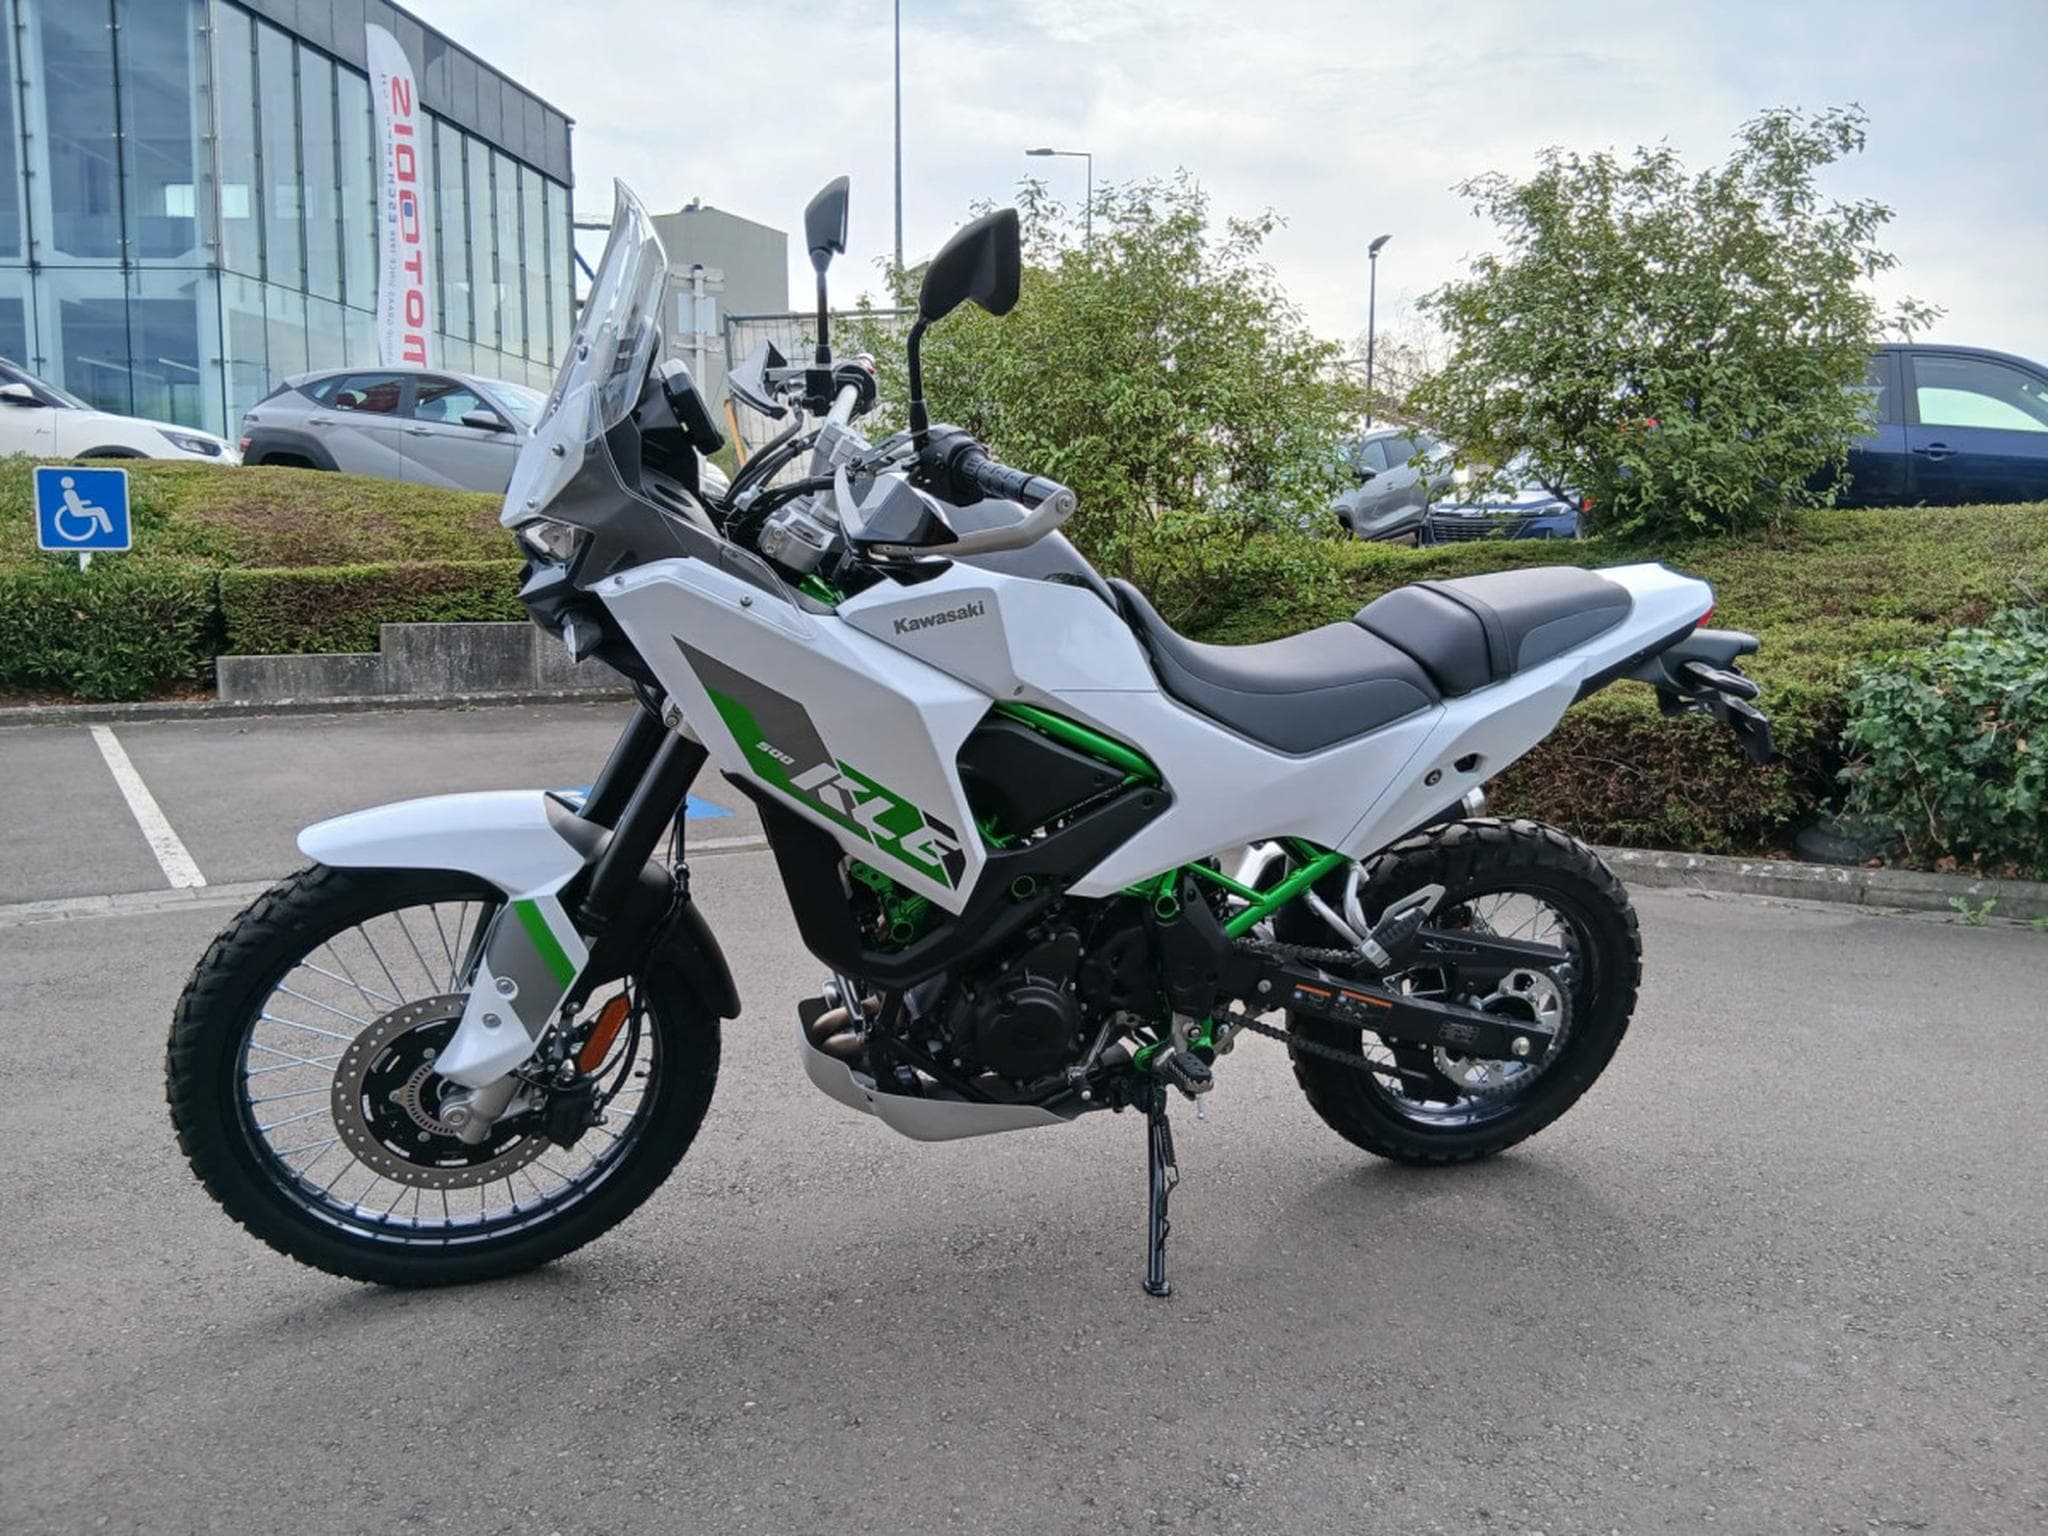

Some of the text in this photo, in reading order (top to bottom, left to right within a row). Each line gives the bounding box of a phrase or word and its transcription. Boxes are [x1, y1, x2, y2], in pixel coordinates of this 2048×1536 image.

[894, 601, 985, 634] Kawasaki
[756, 741, 795, 765] 500
[789, 762, 960, 867] KLE
